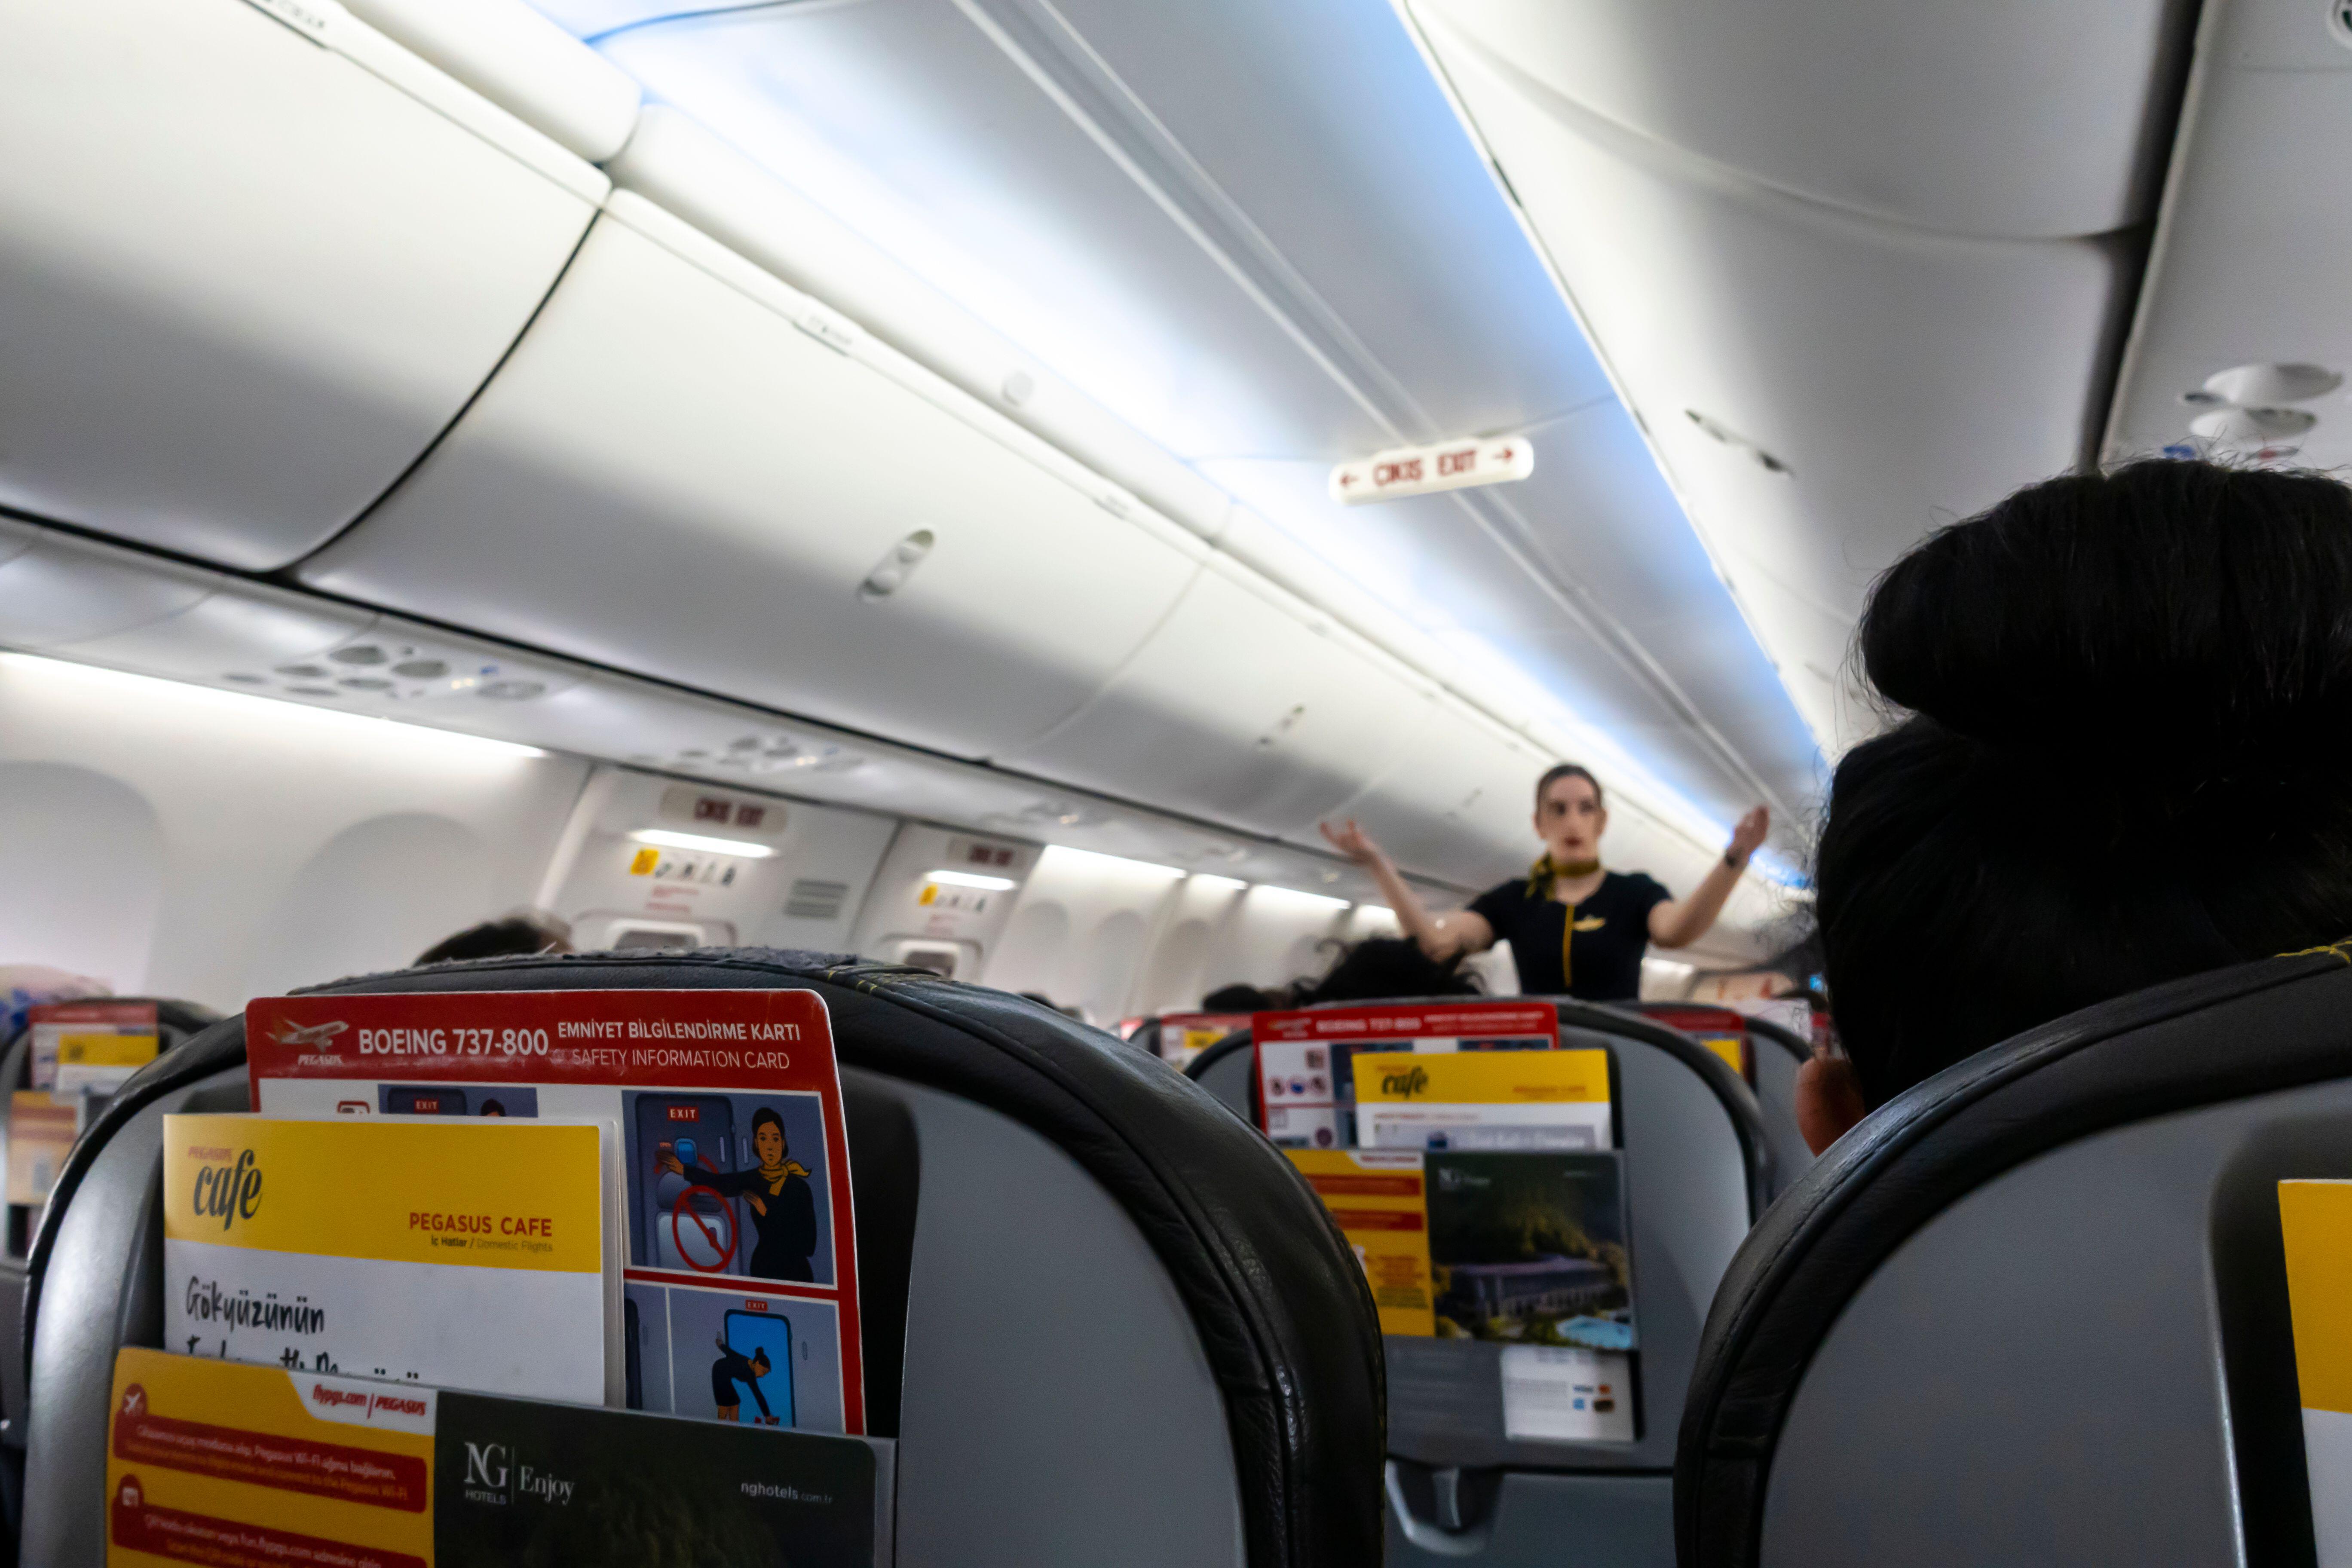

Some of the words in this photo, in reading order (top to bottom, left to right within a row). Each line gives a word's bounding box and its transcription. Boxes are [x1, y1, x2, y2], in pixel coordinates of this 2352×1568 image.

[558, 1018, 624, 1038] EMNİYET
[628, 1018, 747, 1040] BİLGİLENDİRME
[750, 1023, 801, 1041] KARTI
[358, 1029, 446, 1055] BOEING
[452, 1029, 548, 1056] 737-800
[573, 1049, 627, 1065] SAFETY
[632, 1050, 740, 1068] INFORMATION
[744, 1052, 790, 1069] CARD
[415, 1099, 438, 1111] EXIT
[670, 1109, 696, 1119] EXIT
[410, 1212, 492, 1234] PEGASUS
[501, 1217, 552, 1237] CAFE
[186, 1276, 325, 1334] Gökyüzünün
[748, 1302, 766, 1310] EXIT
[464, 1442, 508, 1488] NG
[520, 1464, 574, 1505] Enjoy
[465, 1489, 507, 1505] HOTELS
